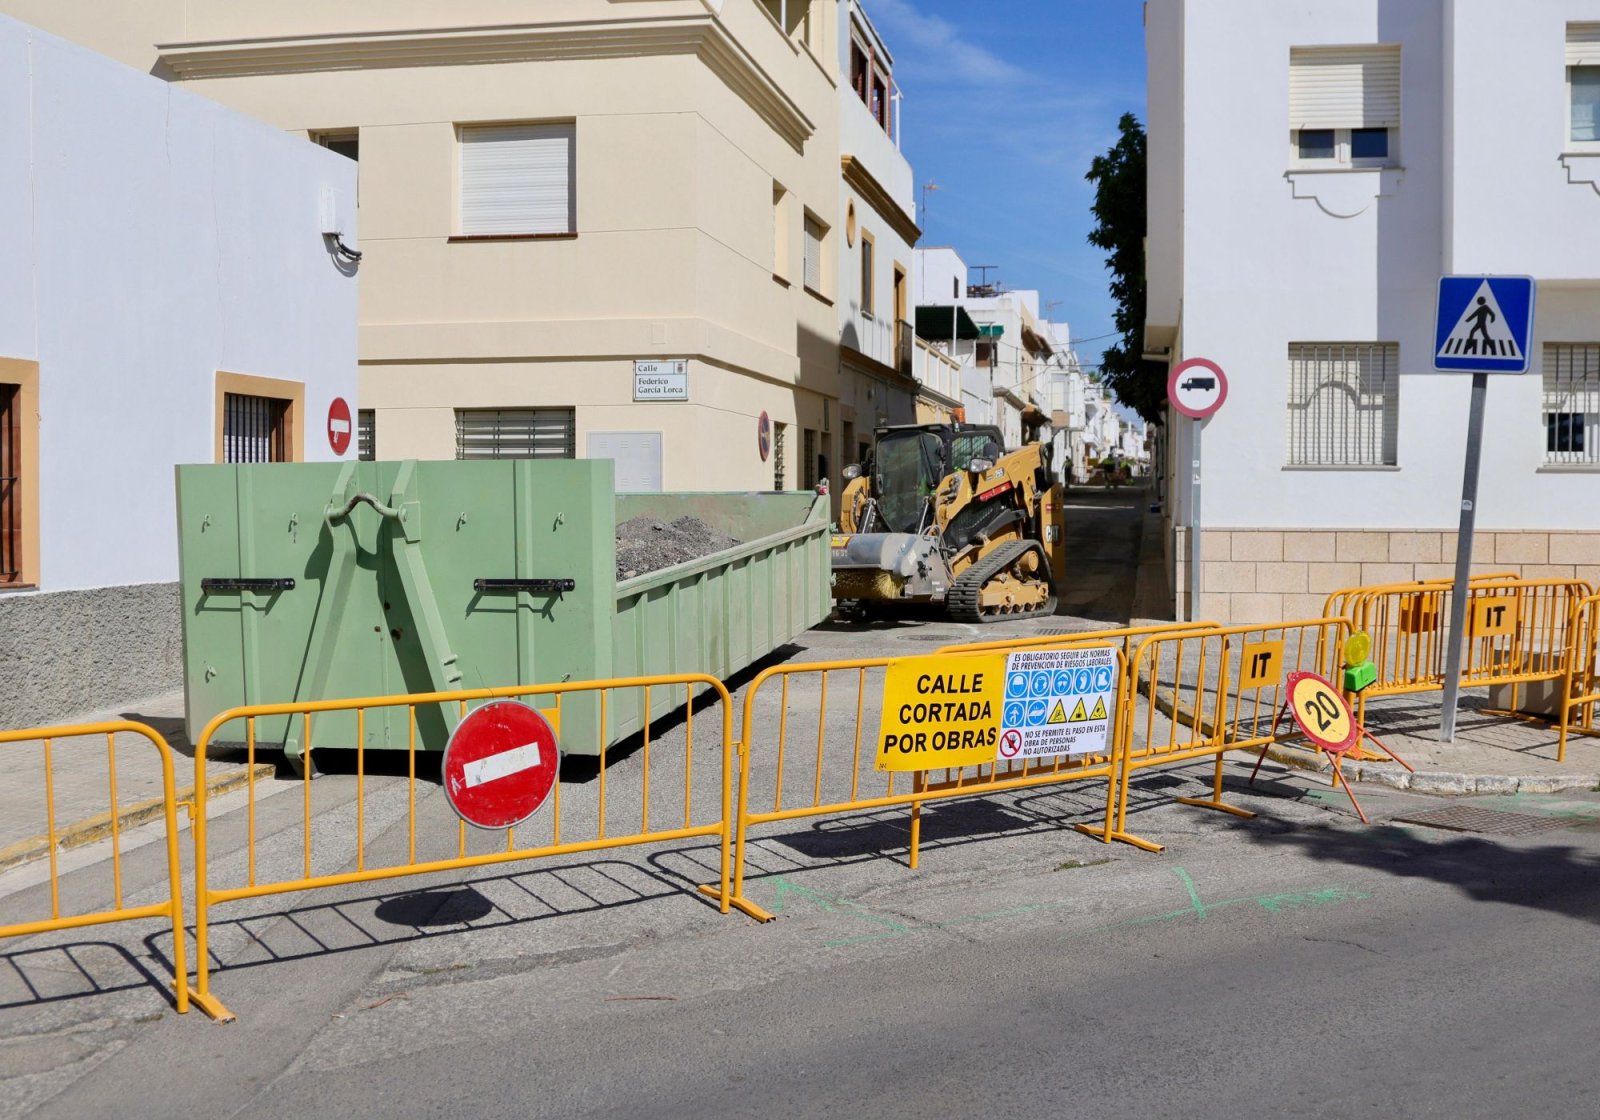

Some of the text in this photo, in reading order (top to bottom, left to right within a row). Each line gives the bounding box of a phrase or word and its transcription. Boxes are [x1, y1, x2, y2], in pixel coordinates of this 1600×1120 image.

[638, 386, 683, 394] García Lorca
[1485, 605, 1507, 628] IT
[1012, 662, 1020, 671] DE
[1056, 660, 1063, 669] DE
[1064, 659, 1086, 668] RIESGOS
[1086, 657, 1112, 667] LABORALES
[1014, 649, 1111, 662] ES OBLIGATORIO SEGUIR LAS NORMAS
[1251, 652, 1272, 679] IT
[916, 673, 984, 694] CALLE
[899, 700, 992, 725] CORTADA
[1304, 690, 1341, 732] 20
[1041, 728, 1065, 737] PERMITE
[1065, 727, 1071, 735] EL
[1072, 726, 1085, 735] PASO
[1086, 725, 1094, 733] EN
[1094, 724, 1106, 732] ESTA
[883, 726, 997, 754] POR OBRAS
[1023, 736, 1077, 747] OBRA DE PERSONAS
[1023, 744, 1070, 756] NO AUTORIZADAS
